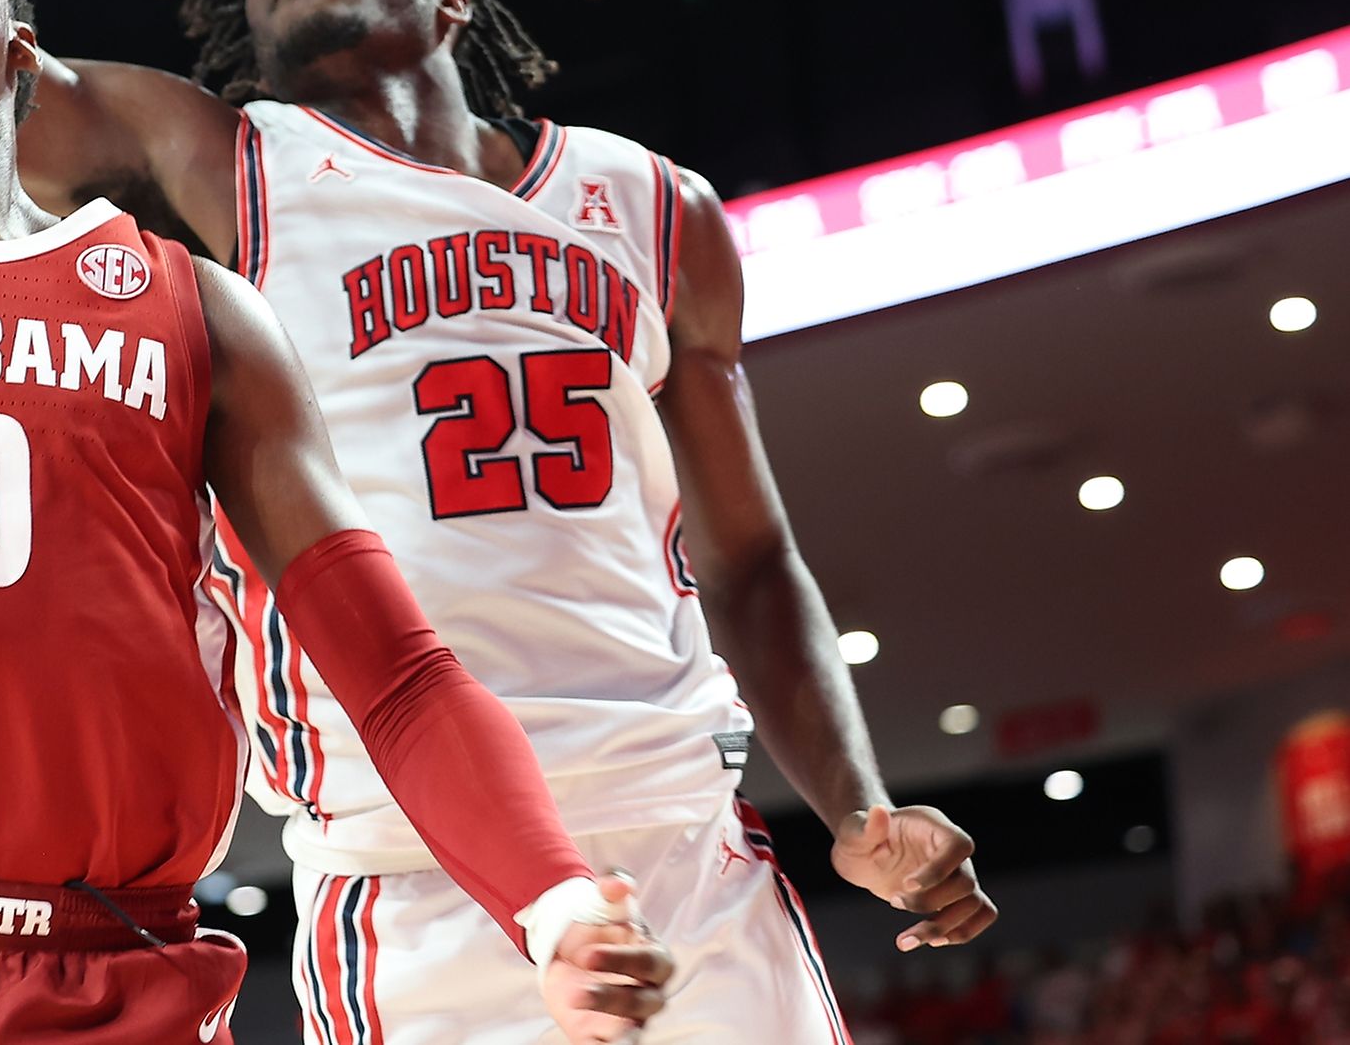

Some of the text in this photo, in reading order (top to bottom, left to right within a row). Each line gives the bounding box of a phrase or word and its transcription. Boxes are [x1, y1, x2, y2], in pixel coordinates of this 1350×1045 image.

[82, 246, 144, 296] SEC
[343, 230, 640, 366] HOUSTON
[412, 348, 614, 521] 25
